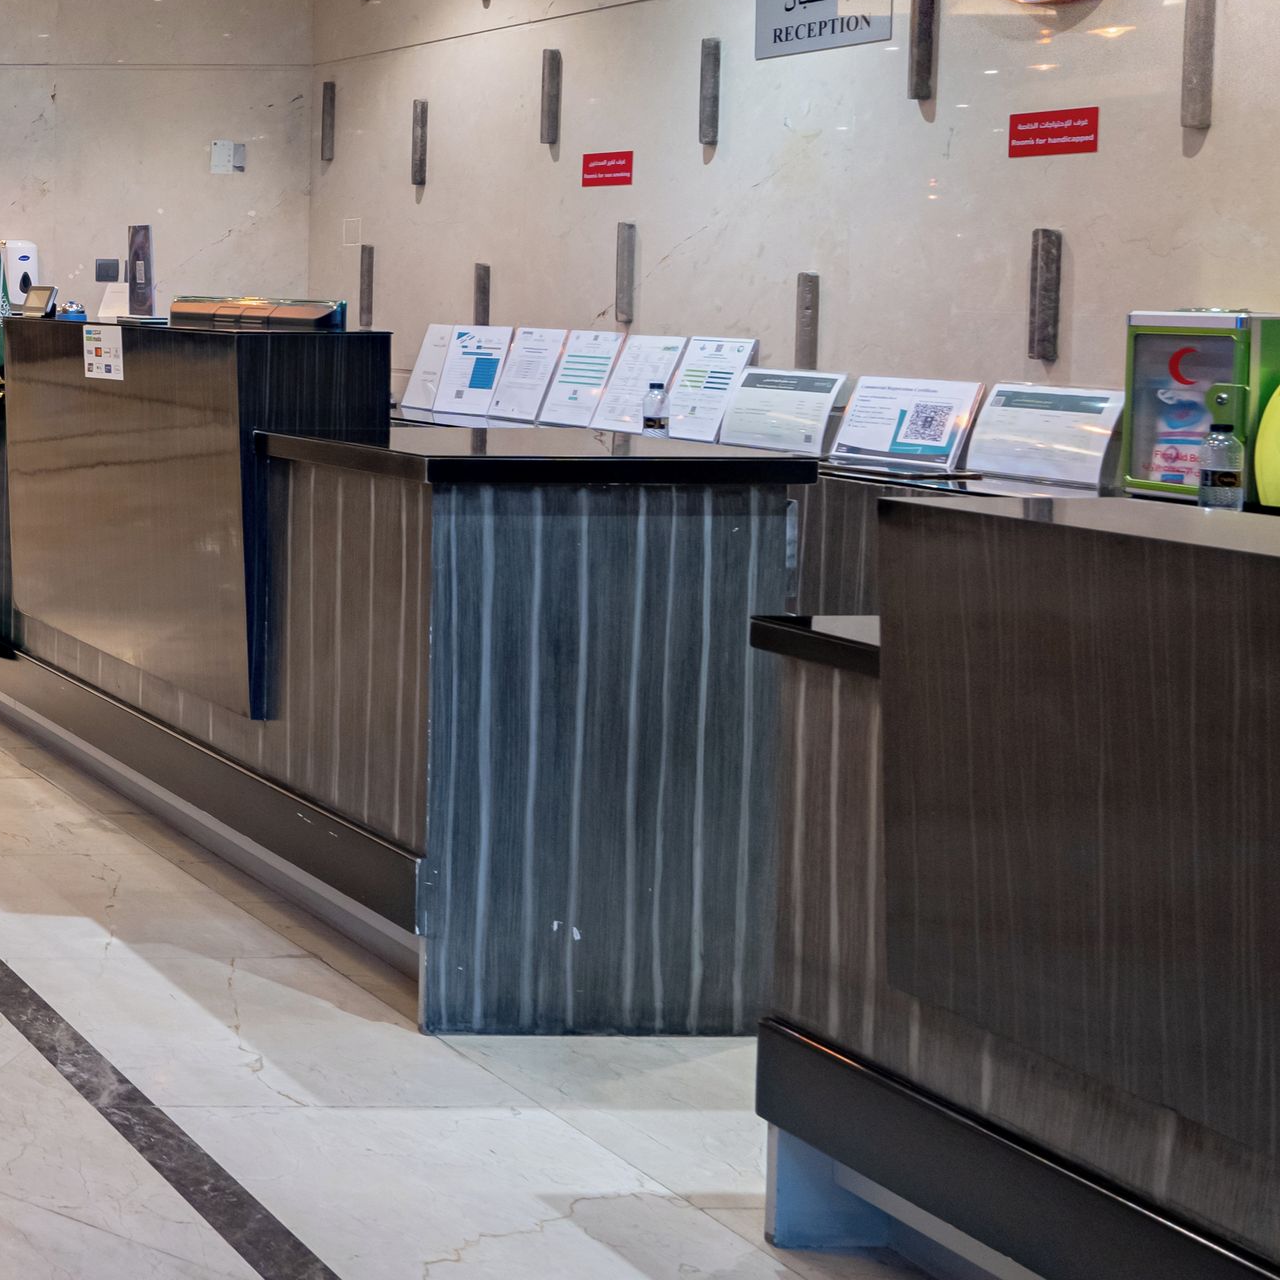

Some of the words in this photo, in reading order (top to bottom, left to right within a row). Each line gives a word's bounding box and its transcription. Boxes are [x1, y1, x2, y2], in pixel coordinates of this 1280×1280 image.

[772, 13, 872, 45] RECEPTION
[1035, 137, 1047, 145] for
[1047, 133, 1095, 144] handicapped
